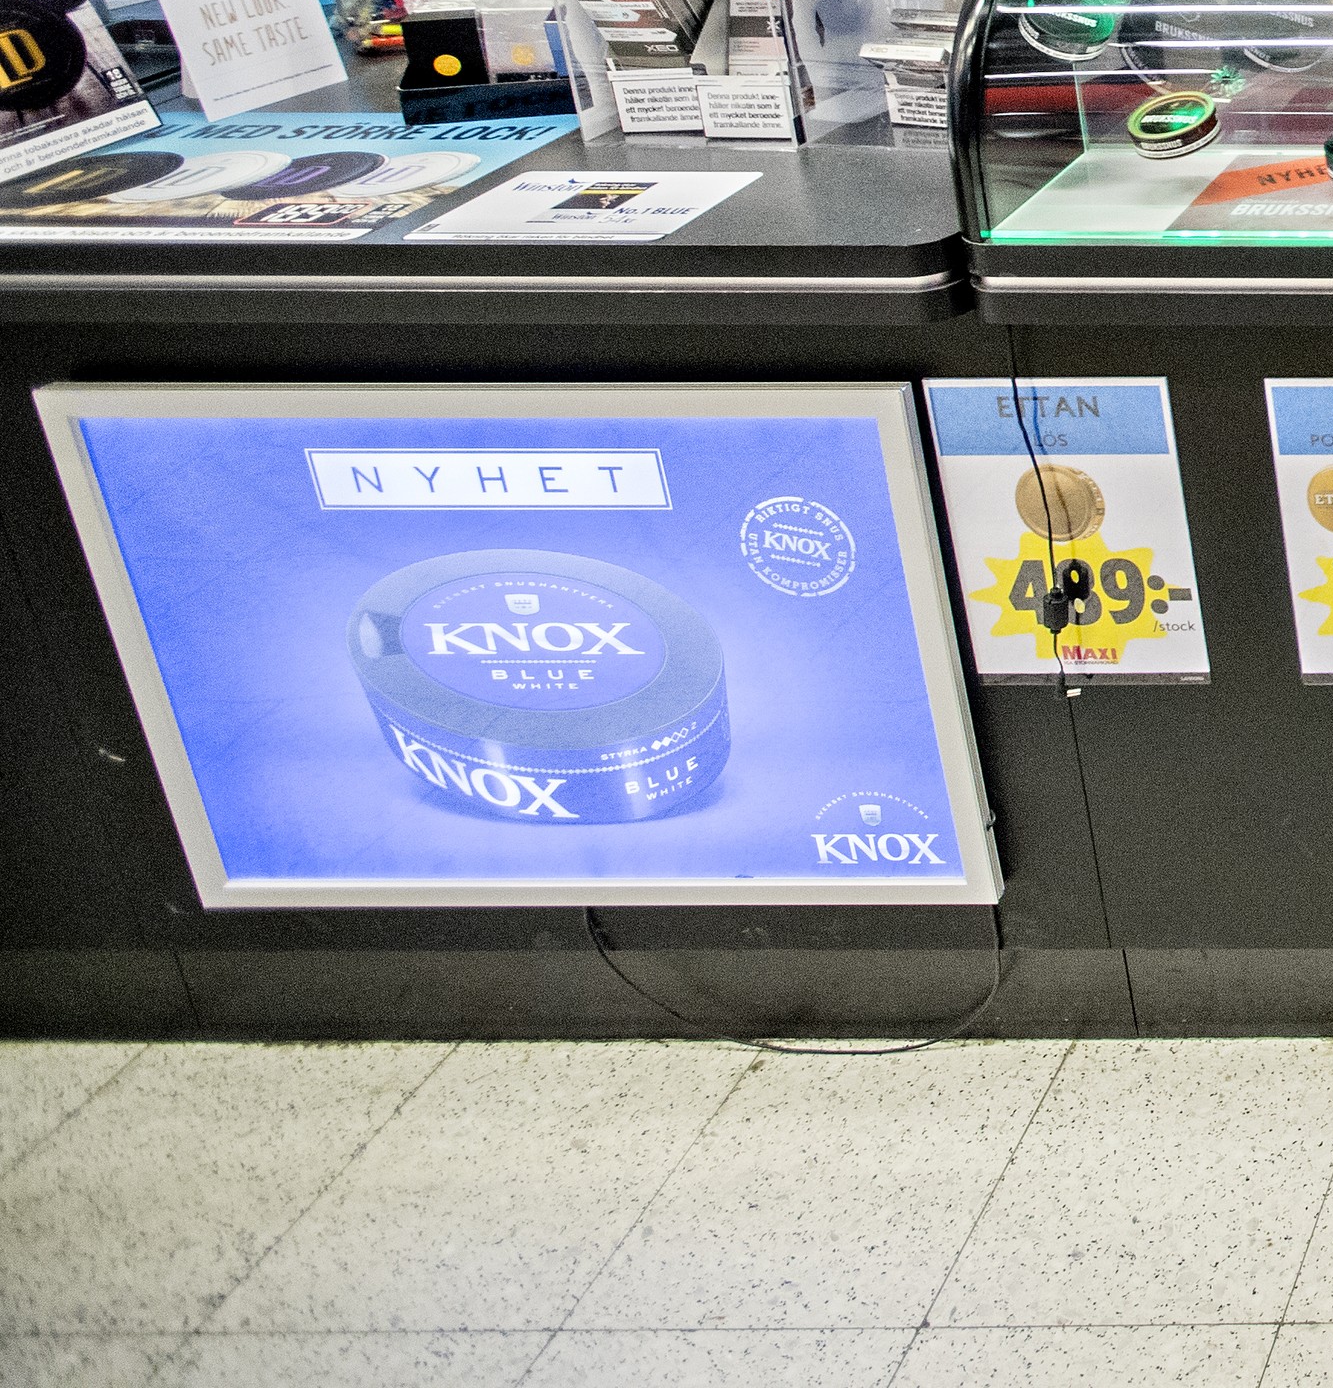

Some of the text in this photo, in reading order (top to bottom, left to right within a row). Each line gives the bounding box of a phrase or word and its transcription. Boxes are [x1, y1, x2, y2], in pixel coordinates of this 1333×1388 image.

[200, 0, 237, 30] NEW
[202, 30, 250, 66] SAME
[708, 93, 730, 101] Denna
[732, 93, 760, 103] produkt
[709, 102, 729, 110] håller
[731, 102, 755, 110] nikotin
[774, 102, 781, 110] är
[713, 121, 760, 129] framkallande
[721, 112, 746, 121] mycket
[288, 119, 557, 141] STÖRRE LOCK!
[513, 179, 582, 193] Winston
[652, 206, 700, 216] BLUE
[996, 396, 1101, 418] ETTAN
[1034, 429, 1068, 447] LÖS
[352, 465, 626, 495] NYHET
[755, 502, 843, 542] RIKTIGT SNUS
[749, 533, 762, 565] UTAN
[763, 530, 832, 561] KNOX
[1153, 620, 1196, 632] /stock
[424, 622, 645, 655] KNOX
[1061, 645, 1118, 660] MAXI
[491, 669, 594, 681] BLUE
[512, 682, 579, 690] WHITE
[601, 746, 648, 761] STYRKA
[391, 726, 580, 819] KNOX
[625, 756, 698, 794] BLUE
[646, 776, 693, 800] WHITE
[811, 833, 946, 865] KNOX
